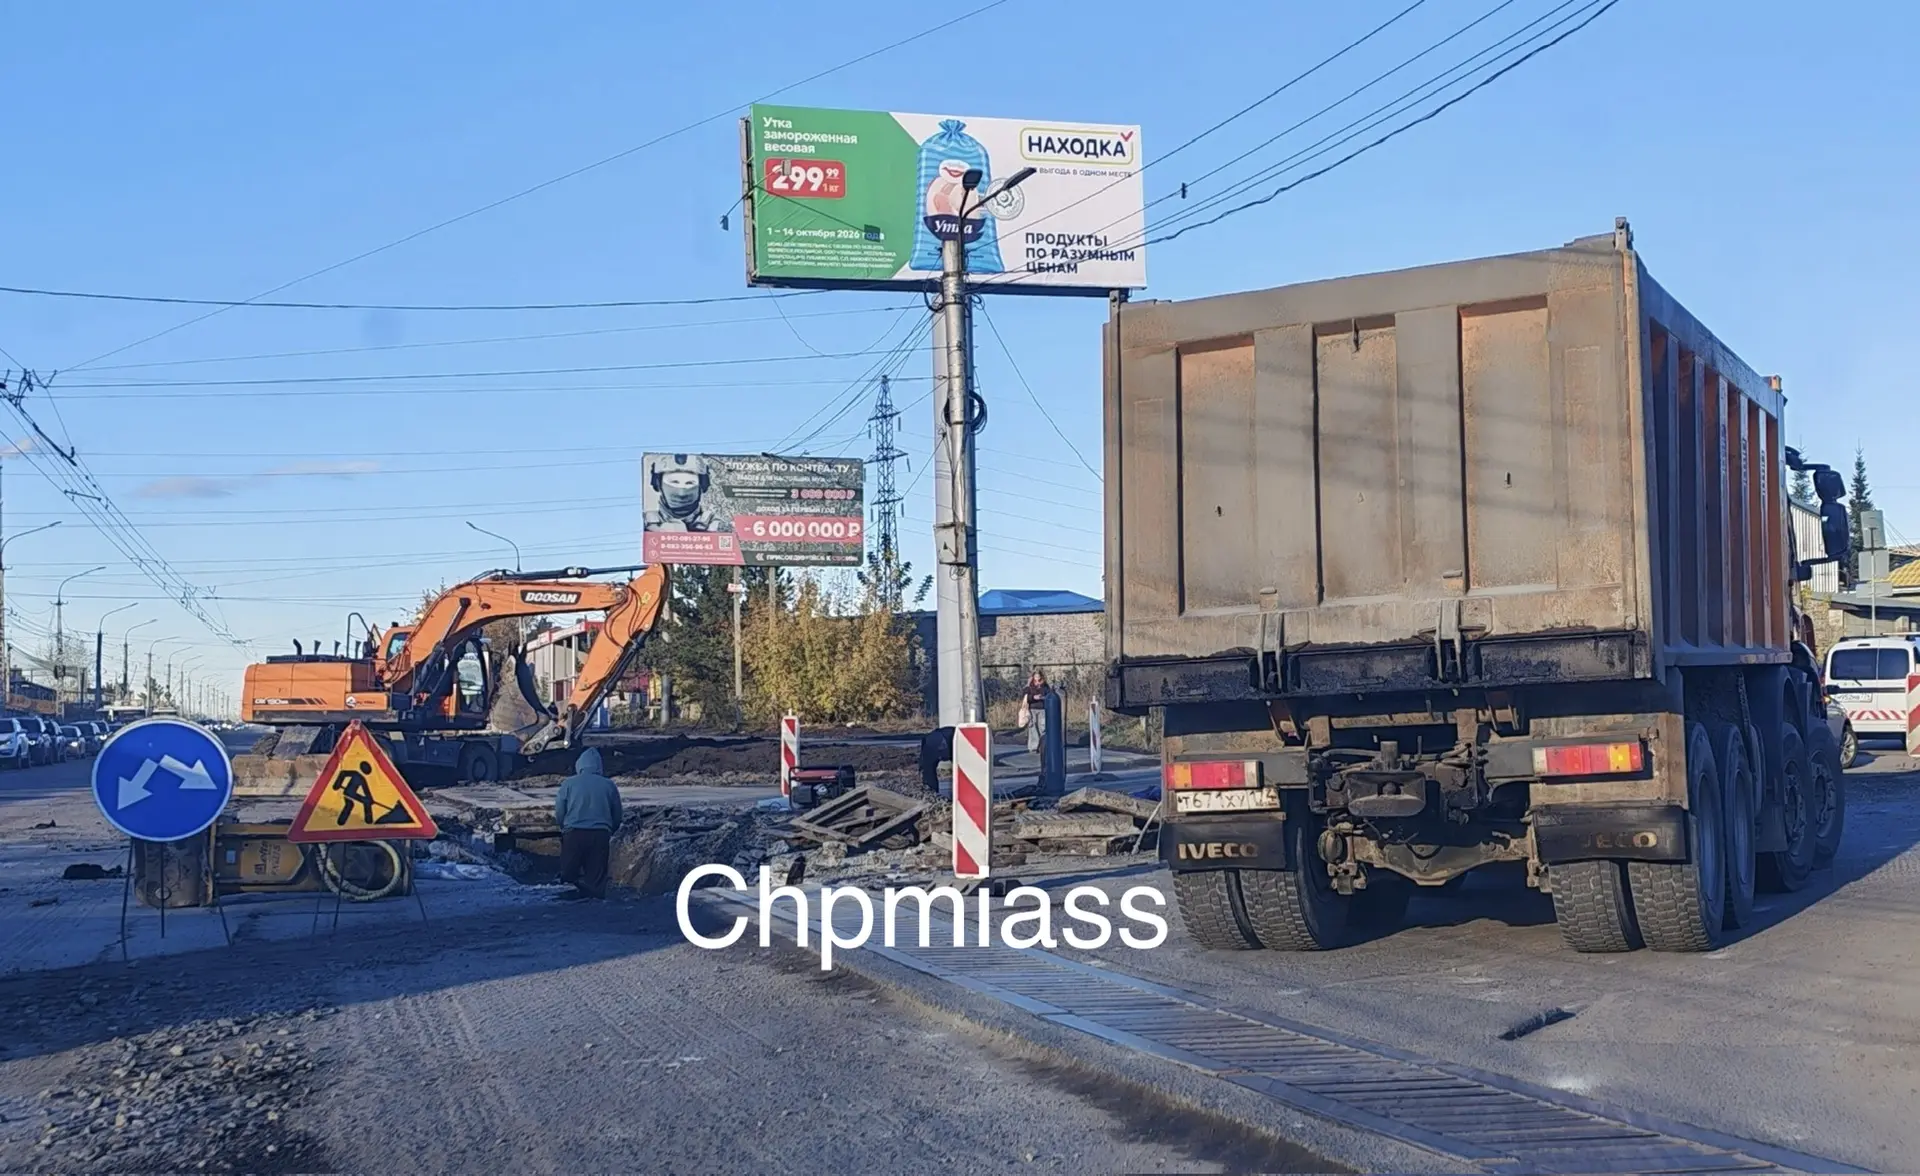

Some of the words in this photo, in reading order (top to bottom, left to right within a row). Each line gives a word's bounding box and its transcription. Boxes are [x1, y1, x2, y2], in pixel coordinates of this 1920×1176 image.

[763, 117, 792, 129] Утка
[764, 130, 857, 144] замороженная
[764, 143, 815, 153] весовая
[1028, 135, 1126, 158] НАХОДКА
[826, 168, 839, 178] 99
[1039, 167, 1070, 175] ВЫГОДА
[767, 227, 772, 235] 1
[783, 228, 794, 236] 14
[796, 229, 836, 239] октября
[837, 230, 860, 239] 2026
[935, 220, 973, 234] Ута
[1025, 232, 1107, 247] ПРОДУКТЫ
[1026, 248, 1047, 259] ПО
[1052, 249, 1135, 261] РАЗУМНЫМ
[1026, 262, 1078, 274] ЦЕНАМ
[772, 463, 788, 472] ПО
[769, 521, 806, 537] 000
[808, 522, 845, 538] 000
[525, 592, 577, 603] DOOSAN
[1178, 842, 1260, 859] IVECO
